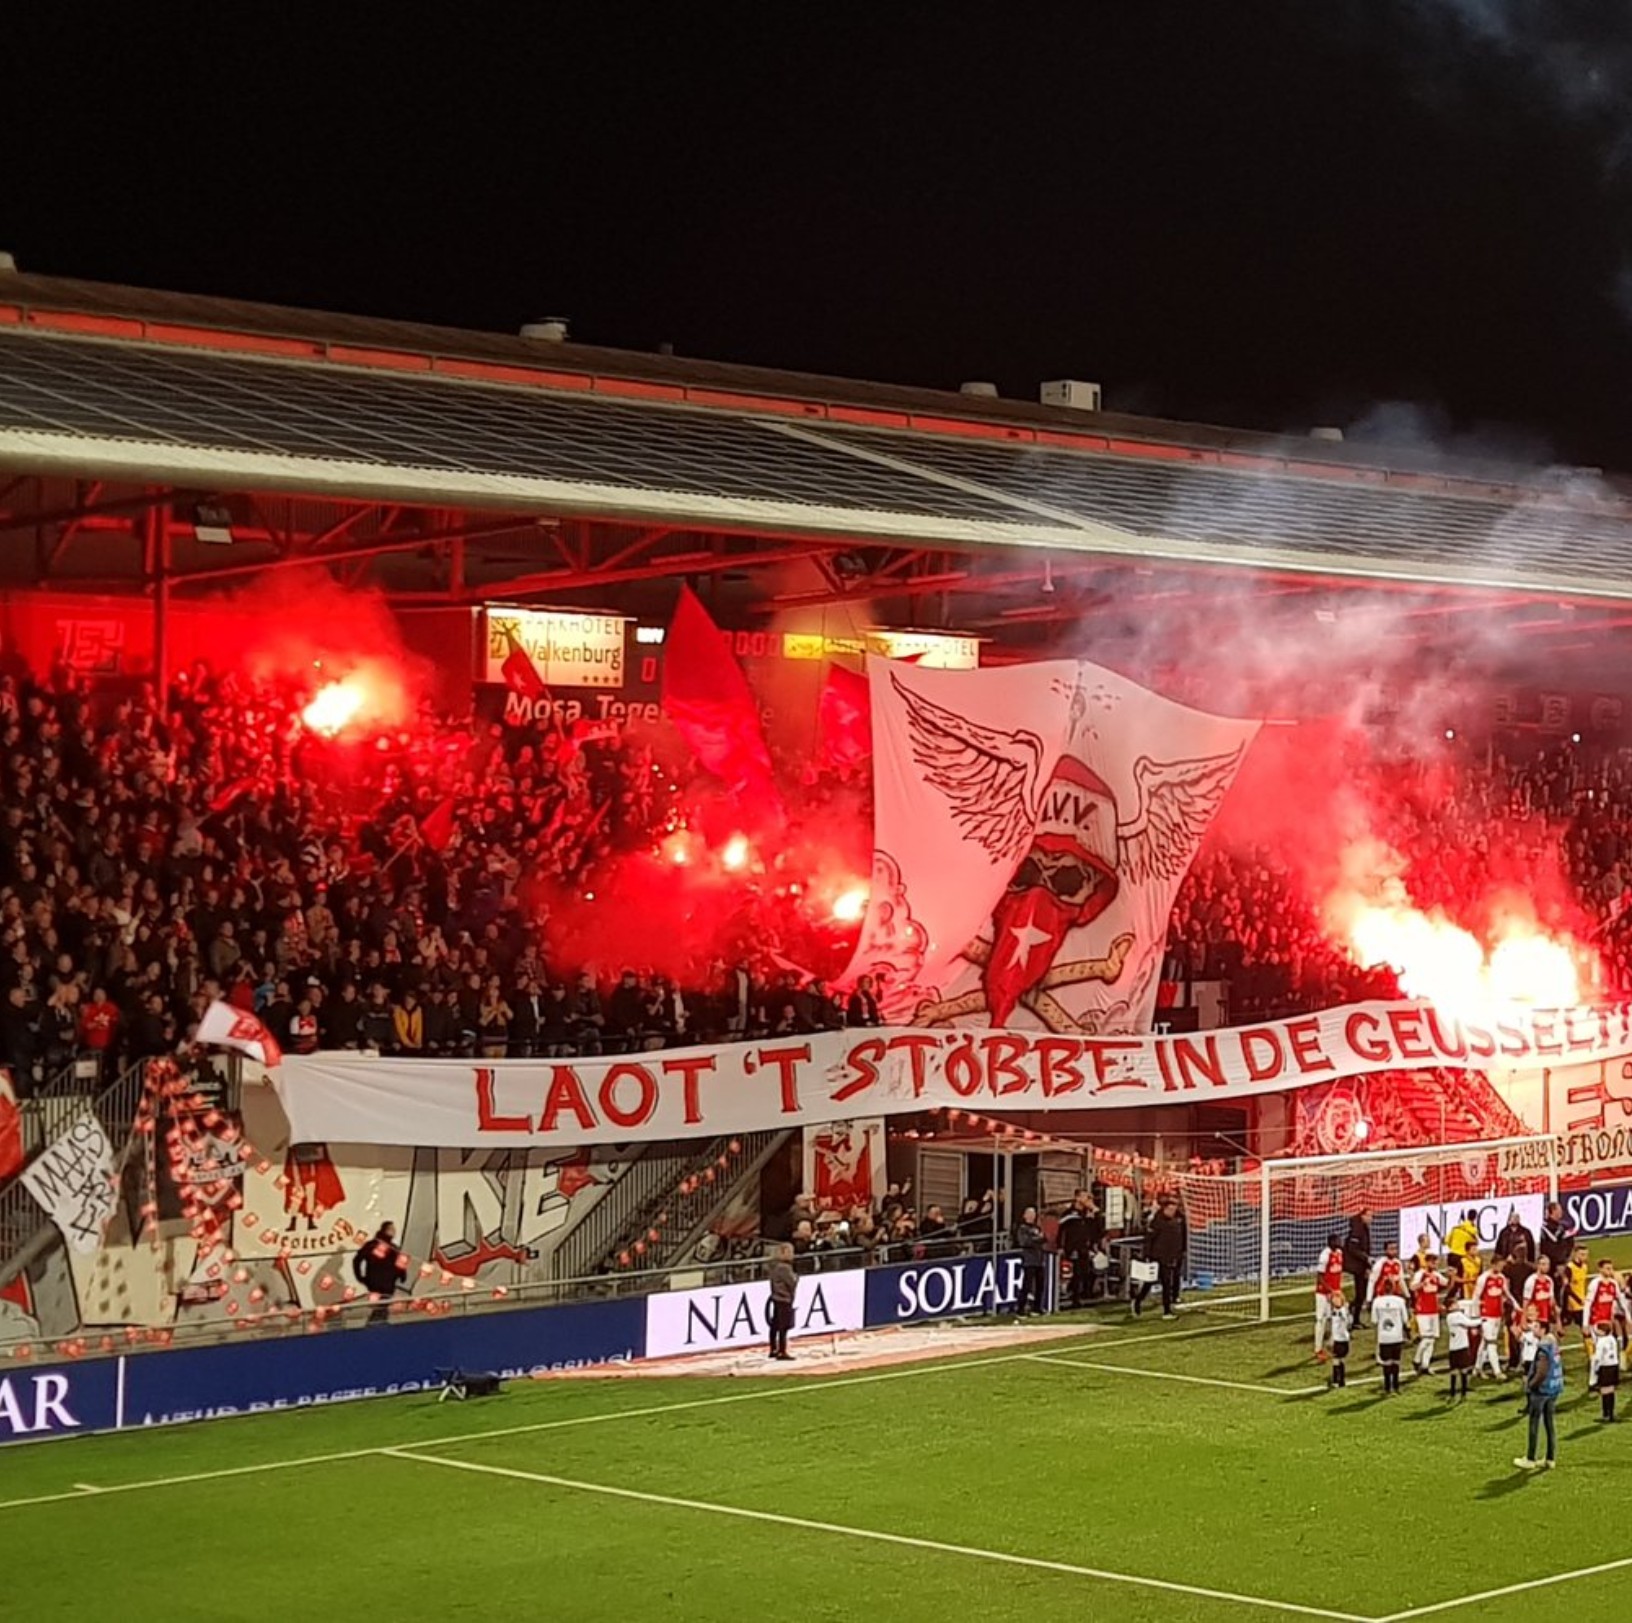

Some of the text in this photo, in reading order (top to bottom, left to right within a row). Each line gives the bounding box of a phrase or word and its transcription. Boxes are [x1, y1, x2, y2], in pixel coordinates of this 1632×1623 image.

[524, 639, 622, 671] Valkenburg
[473, 1053, 717, 1134] LAOT
[830, 1032, 1148, 1101] STÖBBE
[1154, 1036, 1228, 1092] IN
[1239, 1017, 1336, 1082] DE
[685, 1283, 834, 1344] NAA
